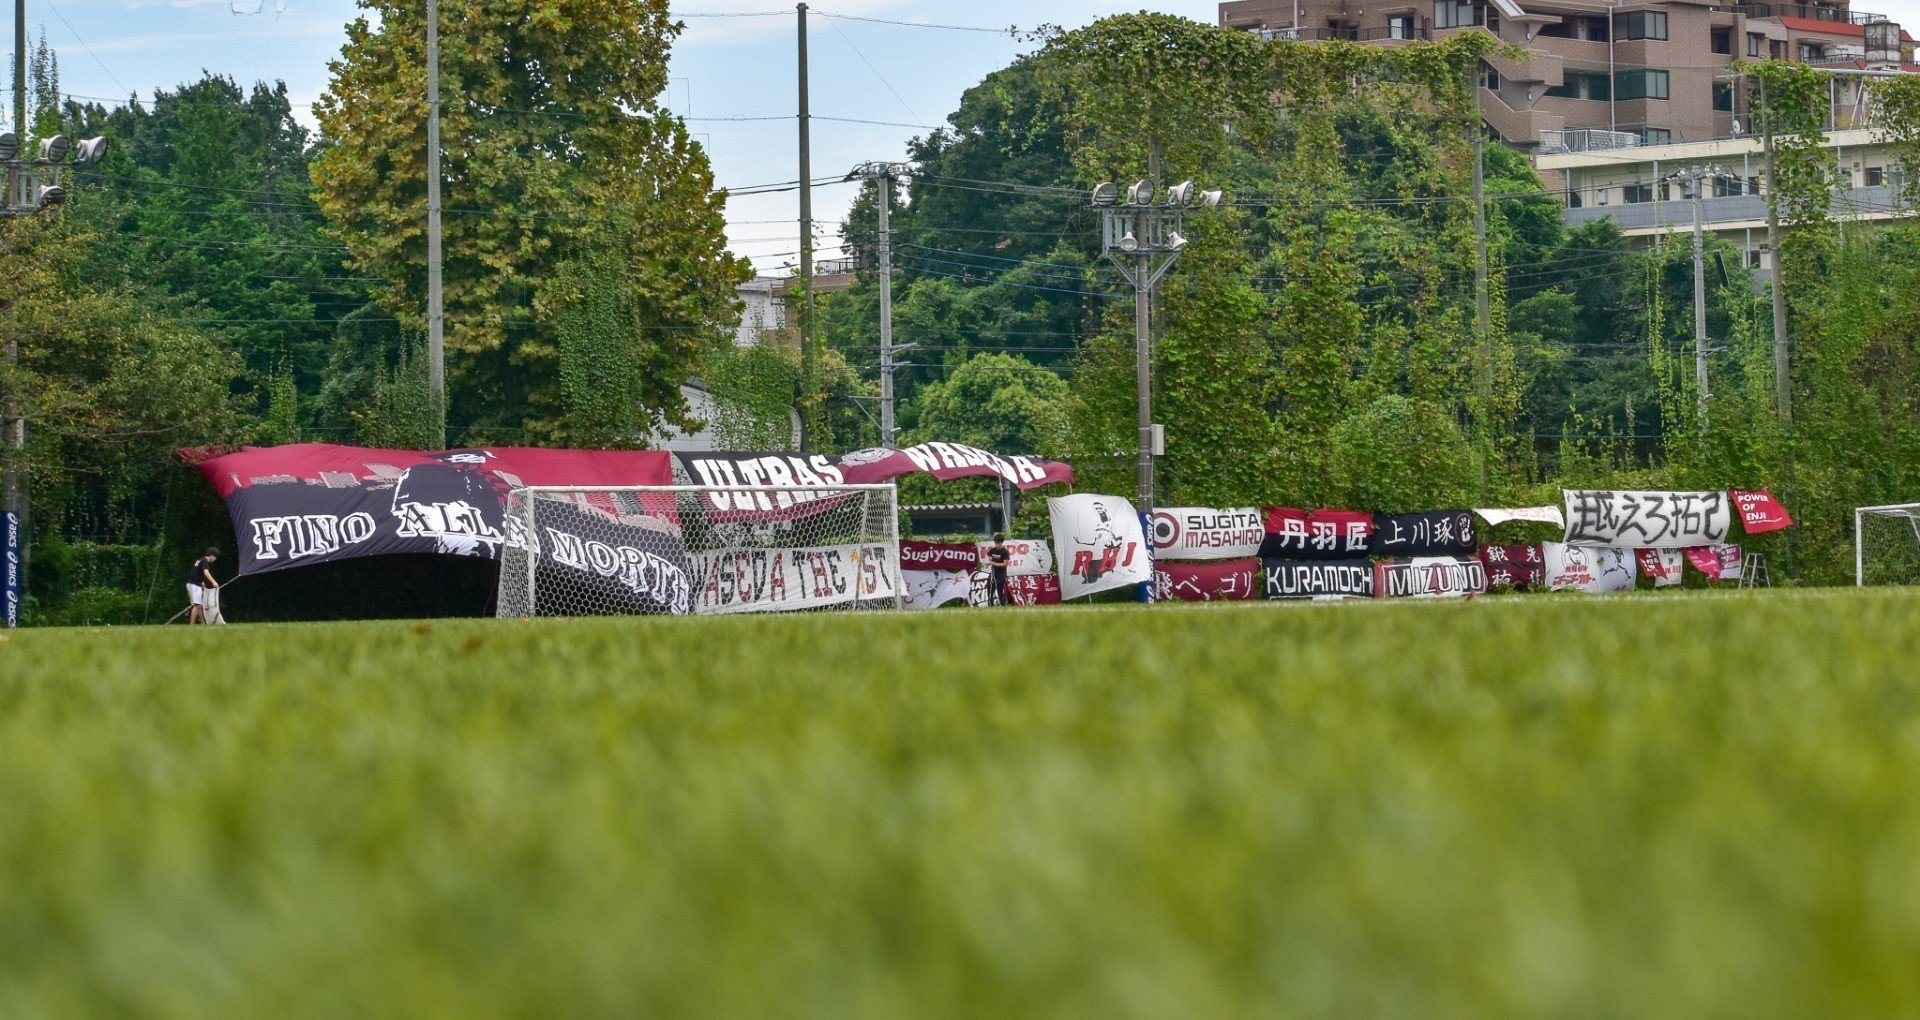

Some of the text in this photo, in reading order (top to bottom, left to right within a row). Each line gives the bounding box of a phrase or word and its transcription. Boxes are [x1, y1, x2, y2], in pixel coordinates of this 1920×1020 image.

[692, 441, 1046, 511] ULTRAS WASEDA
[1742, 503, 1756, 511] OF
[1746, 512, 1767, 521] ENJI
[1187, 514, 1260, 530] SUGITA
[250, 512, 376, 560] FINO
[1185, 528, 1263, 549] MASAHIRO
[901, 546, 976, 563] Sugiyama
[792, 549, 847, 599] THE
[1388, 564, 1483, 596] MIZUNO
